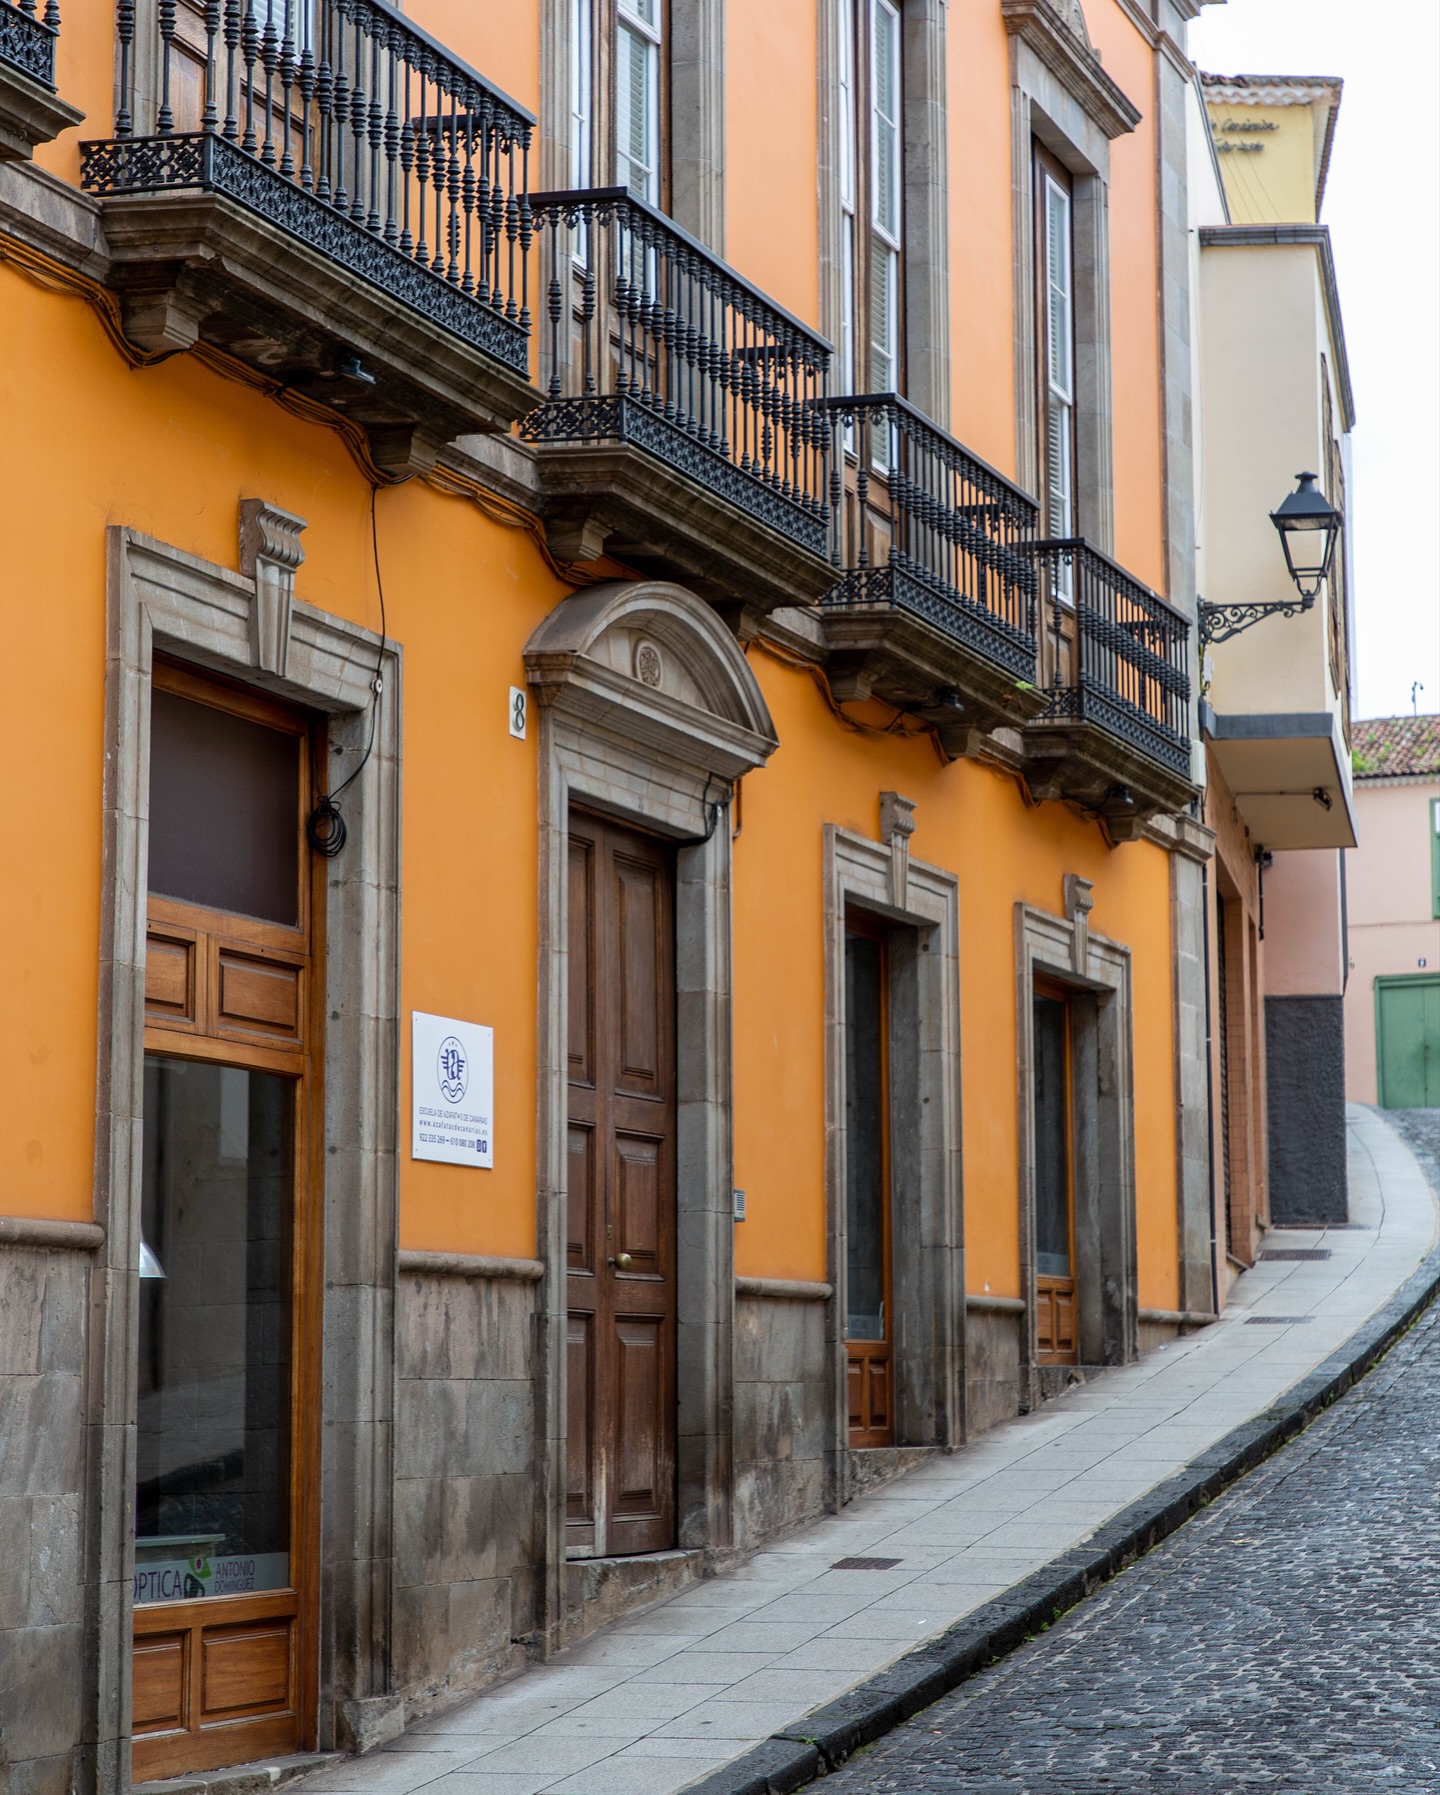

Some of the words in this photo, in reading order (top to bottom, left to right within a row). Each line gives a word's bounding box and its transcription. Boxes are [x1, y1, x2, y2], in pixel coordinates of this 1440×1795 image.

[515, 693, 525, 730] 8
[419, 1106, 436, 1116] ESCUELA
[470, 1115, 488, 1125] CANARIAS
[419, 1120, 488, 1136] www.azafatasdecanarias.es
[419, 1133, 428, 1142] 922
[428, 1134, 436, 1143] 335
[216, 1560, 255, 1579] ANTONIO
[214, 1577, 255, 1593] DOMINGUEZ
